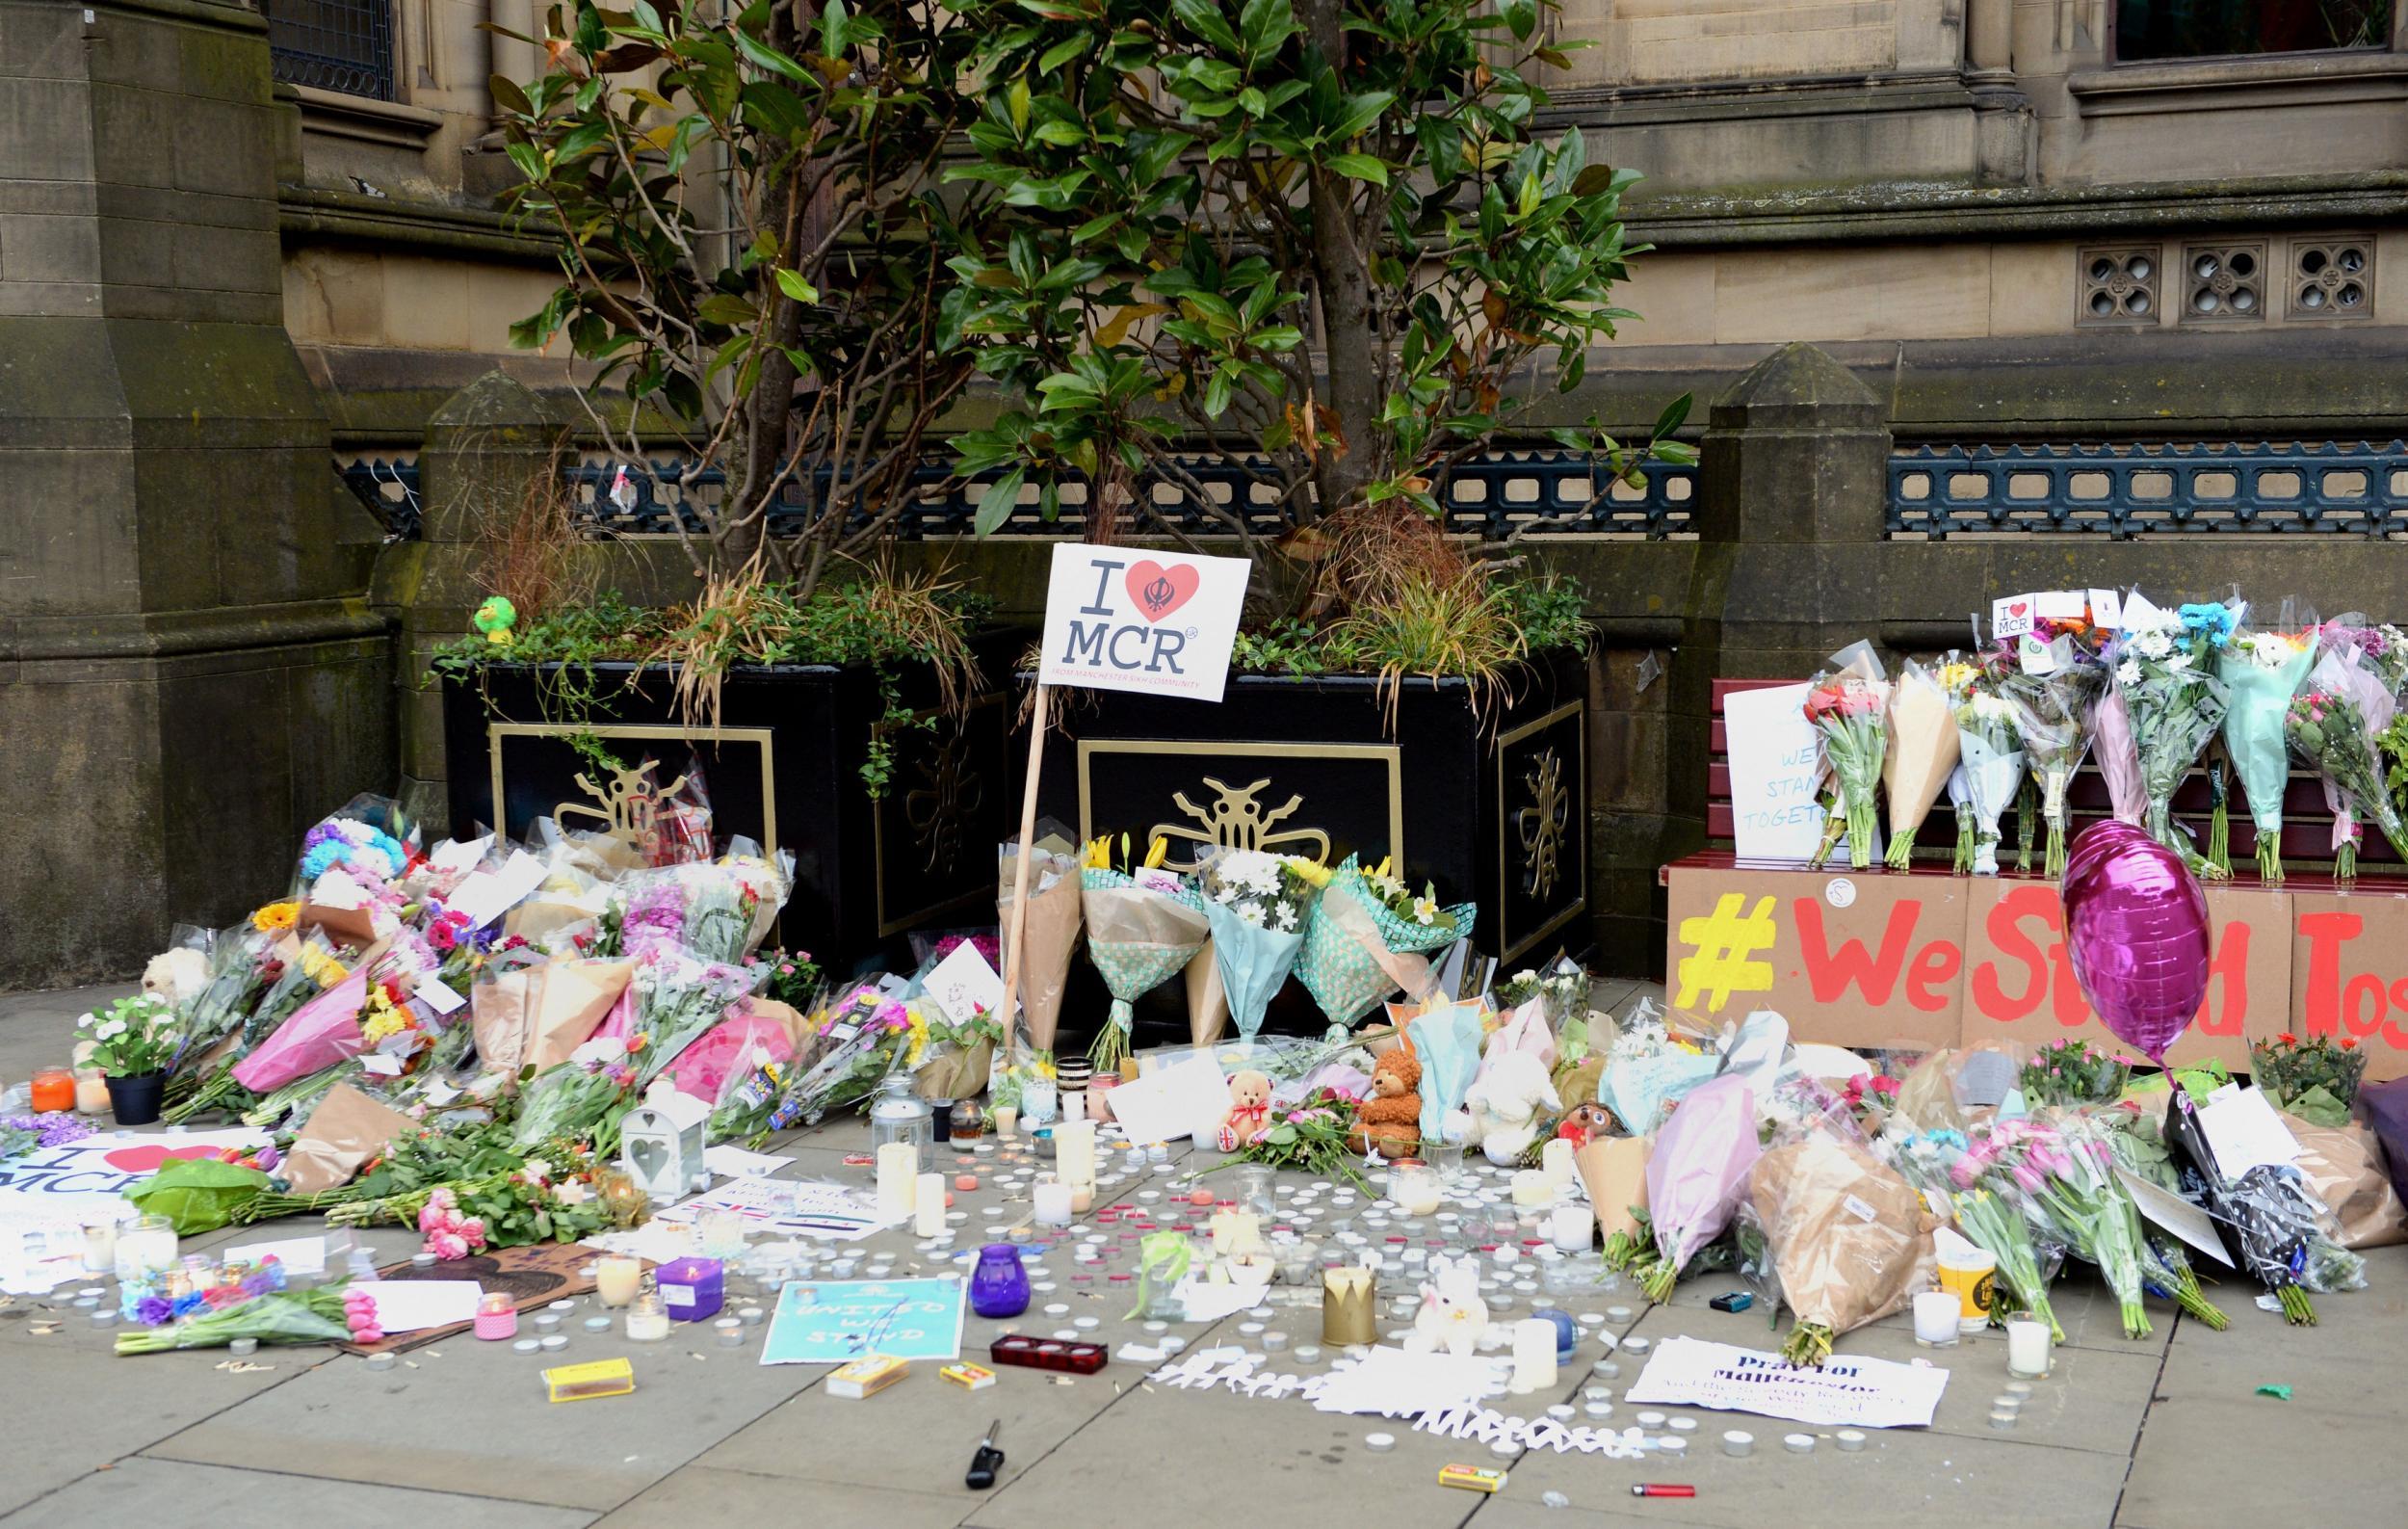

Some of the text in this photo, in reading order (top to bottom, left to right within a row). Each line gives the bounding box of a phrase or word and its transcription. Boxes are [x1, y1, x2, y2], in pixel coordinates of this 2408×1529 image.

[1080, 559, 1125, 617] I
[2000, 606, 2009, 621] I
[1999, 618, 2028, 634] MCR
[1061, 620, 1186, 674] MCR
[1075, 669, 1127, 682] MANCHESTER
[1149, 676, 1200, 690] COMMUNITY
[1782, 747, 1817, 767] WE
[17, 1147, 111, 1170] I
